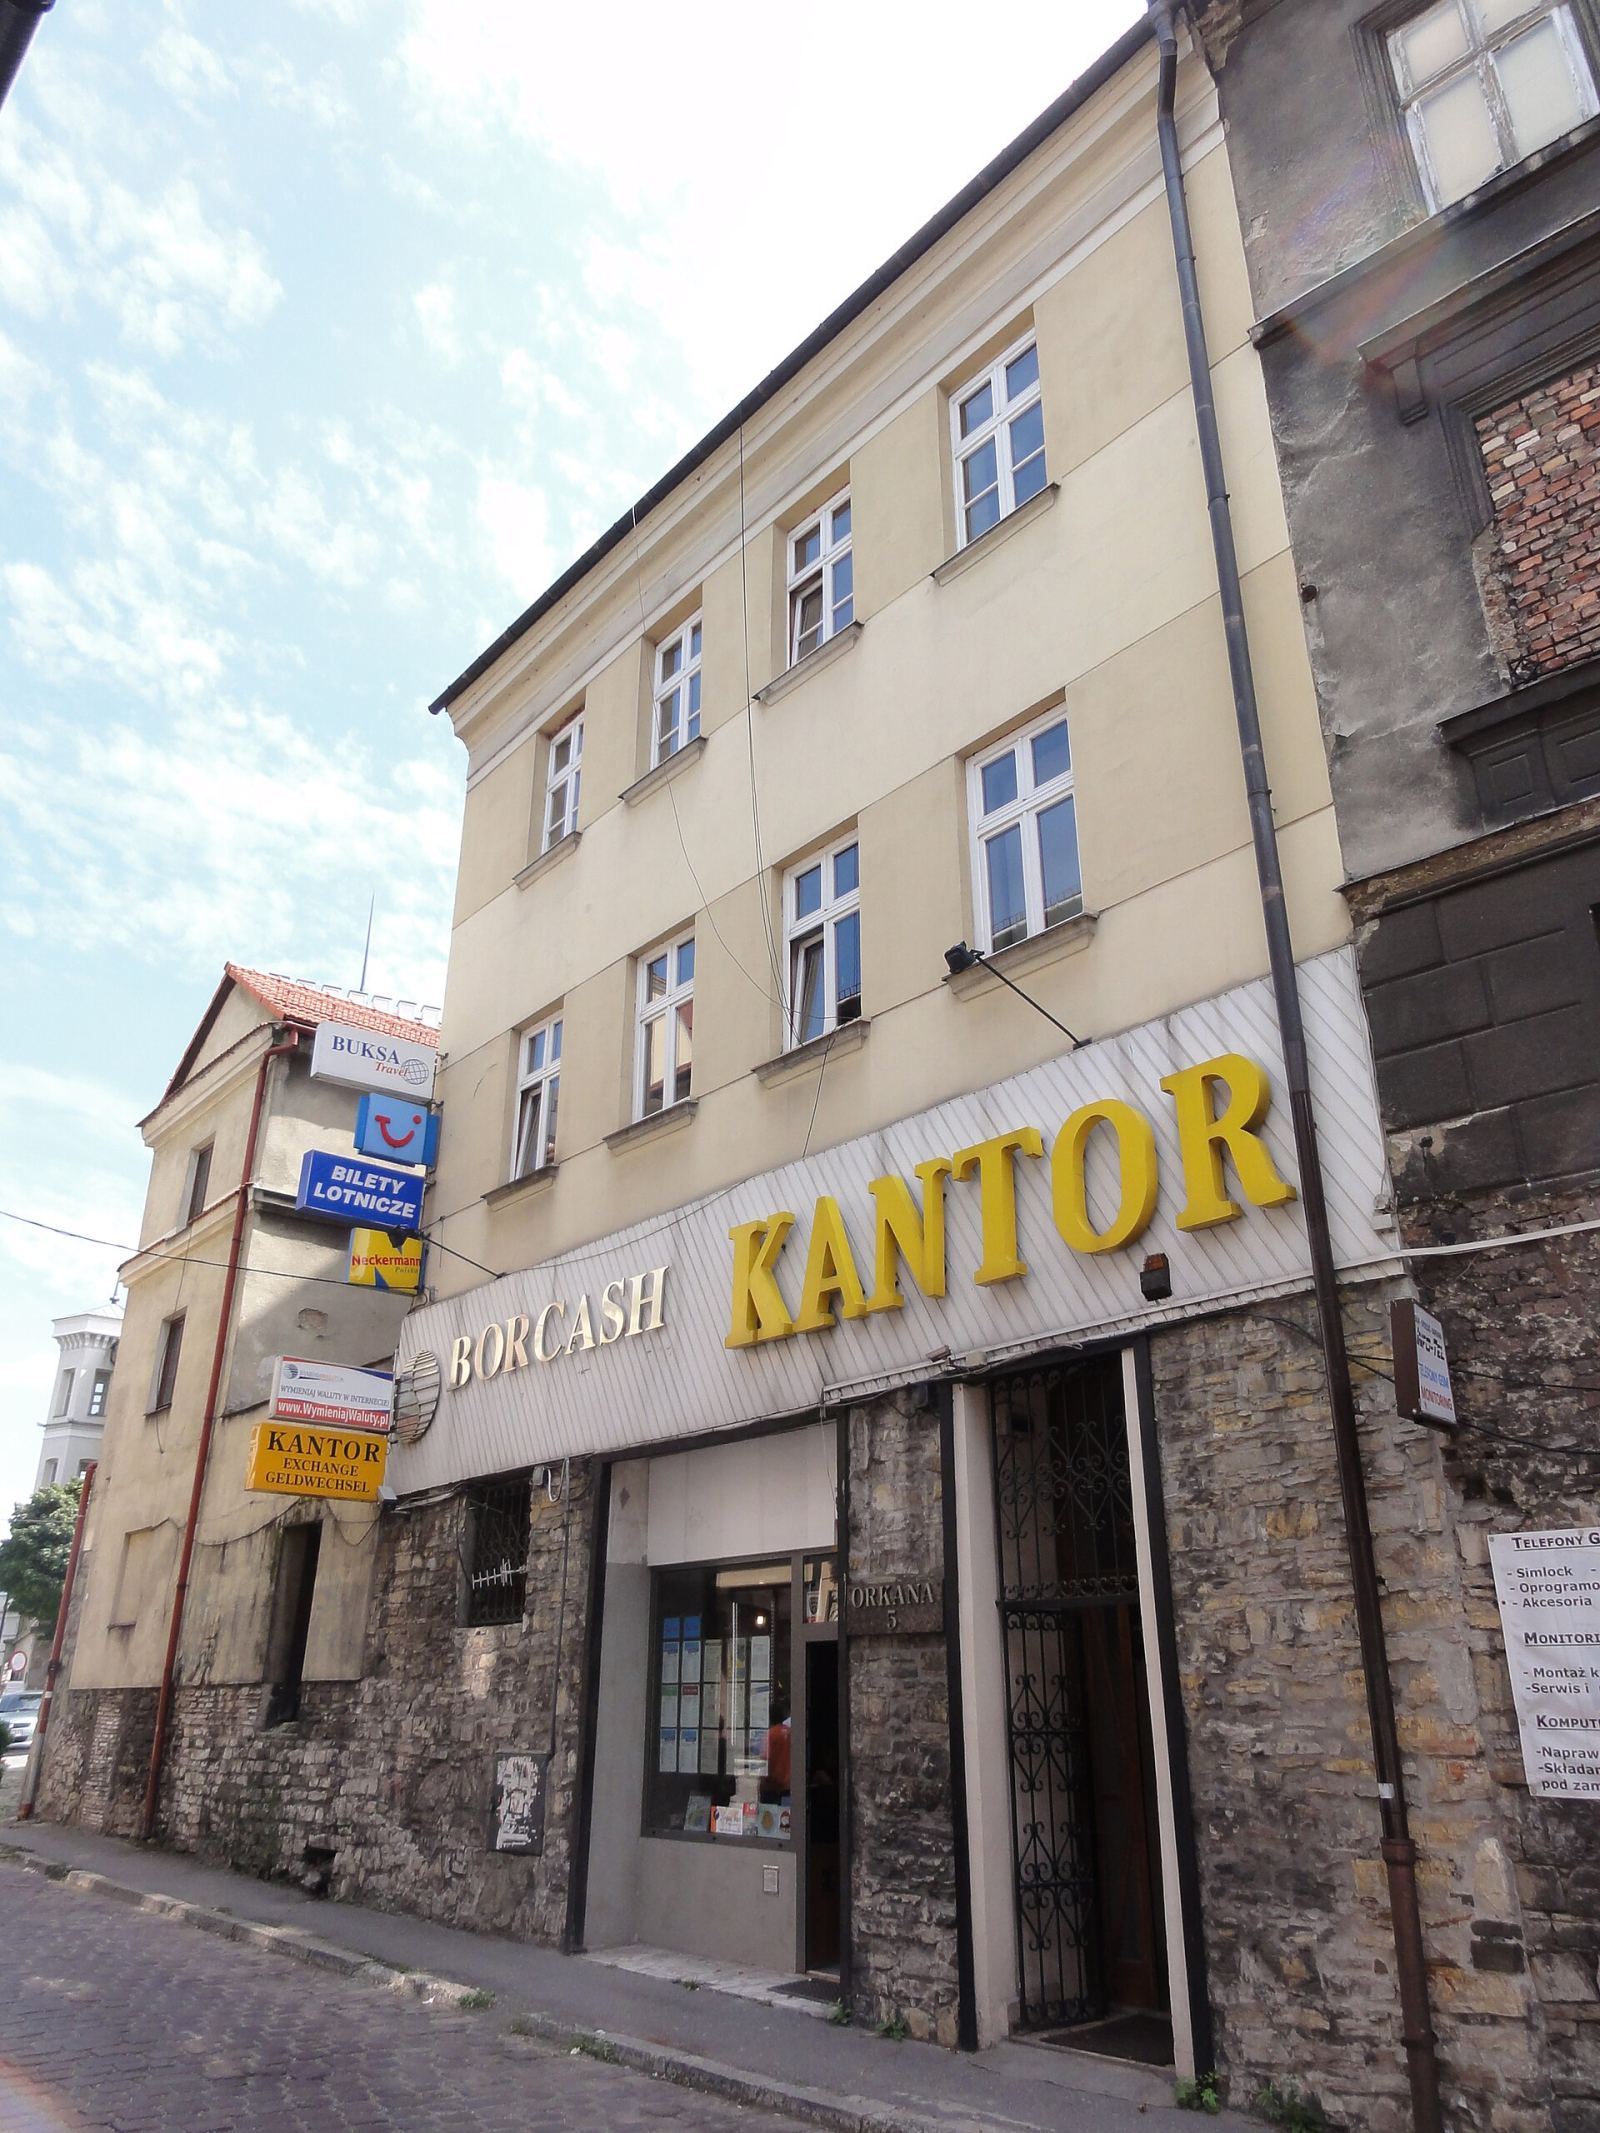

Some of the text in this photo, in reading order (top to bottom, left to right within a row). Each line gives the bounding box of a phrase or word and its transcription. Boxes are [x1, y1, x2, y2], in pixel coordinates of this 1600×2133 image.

[331, 1035, 400, 1064] BUKSA
[375, 1061, 409, 1077] Travel
[331, 1165, 405, 1194] BILETY
[313, 1182, 416, 1218] LOTNICZE
[725, 1052, 1297, 1350] KANTOR
[351, 1253, 421, 1266] Neckermann
[447, 1265, 671, 1393] BORCASH
[280, 1384, 316, 1398] WYMIENIAJ
[317, 1388, 343, 1401] WALUTY
[277, 1401, 389, 1427] www.WymieniajWaluty.pl
[266, 1430, 381, 1463] KANTOR
[283, 1457, 359, 1477] EXCHANGE
[265, 1471, 370, 1493] GELDWECHSEL
[1511, 1536, 1583, 1549] TELEFONY
[1516, 1566, 1573, 1578] Simlock
[851, 1582, 935, 1608] ORKANA
[1522, 1595, 1592, 1608] Akcesoria
[887, 1609, 897, 1629] 5
[1533, 1667, 1586, 1678] Montaż
[1541, 1779, 1568, 1791] pod
